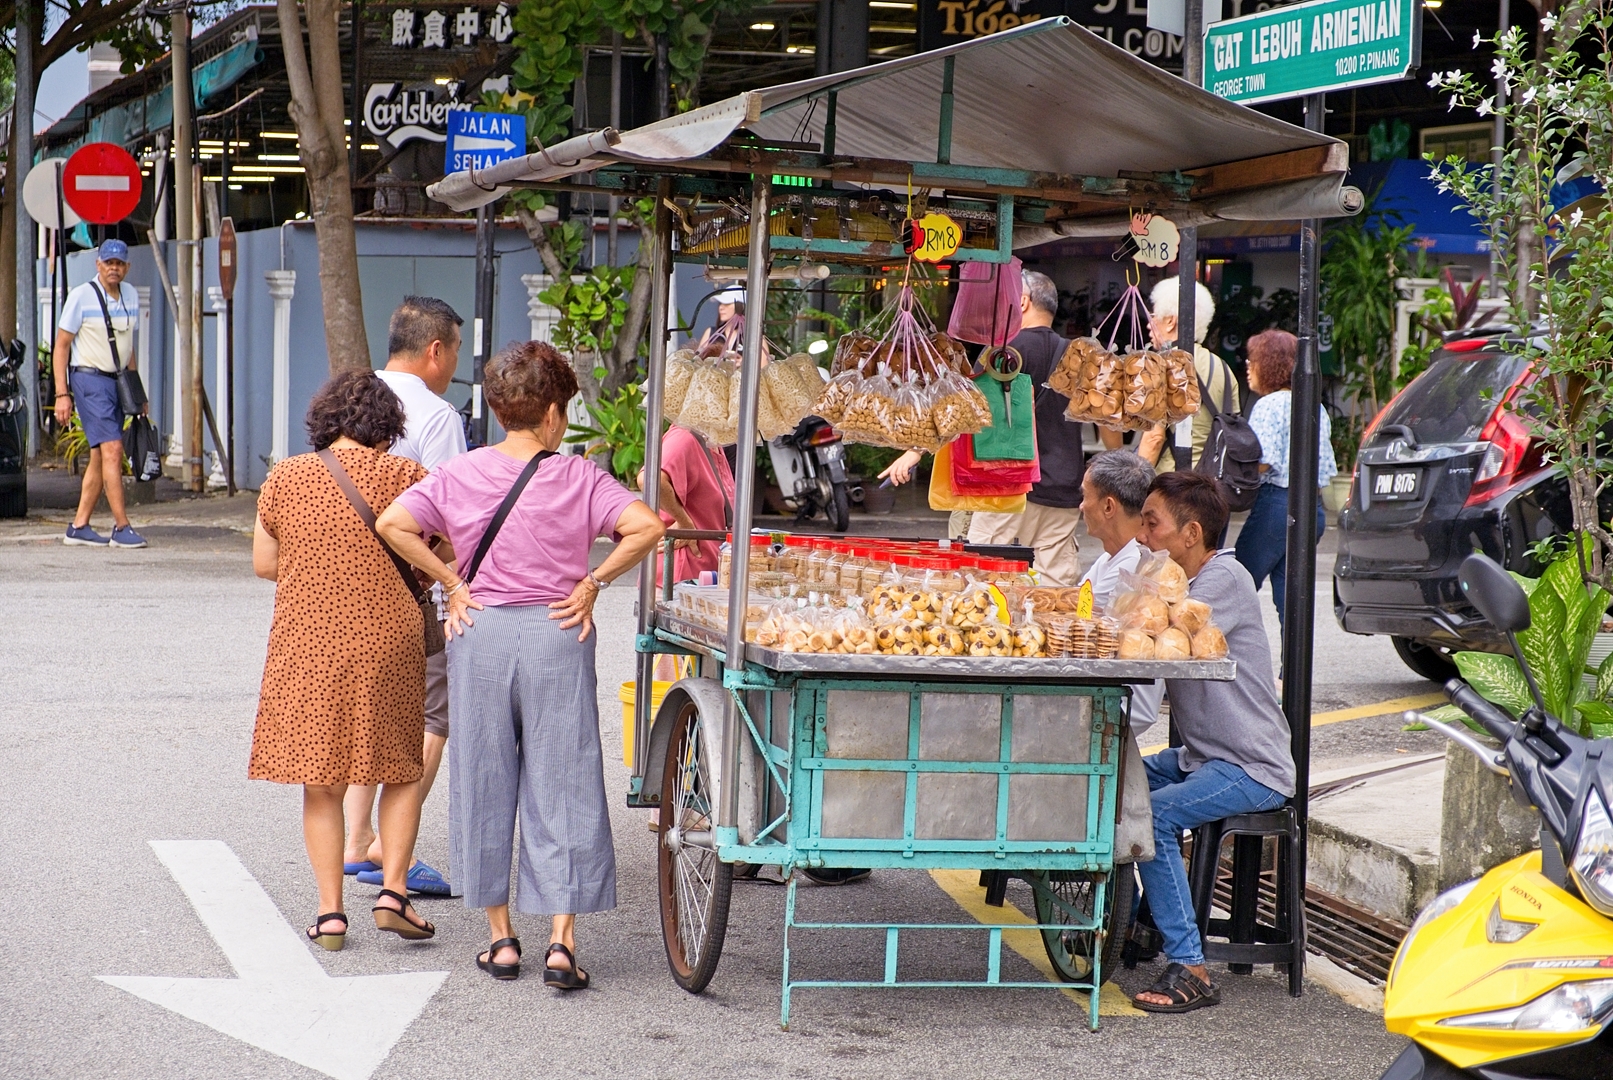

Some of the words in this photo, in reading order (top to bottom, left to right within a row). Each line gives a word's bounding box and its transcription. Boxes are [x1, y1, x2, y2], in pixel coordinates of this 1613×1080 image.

[391, 3, 514, 49] 飲食中心
[1214, 32, 1243, 73] GAT
[1251, 19, 1302, 65] LEBUH
[1310, 1, 1401, 53] ARMENIAN
[1335, 57, 1357, 76] 10200
[1360, 48, 1400, 72] P.PINANG
[1213, 78, 1243, 98] GEORGE
[1245, 73, 1266, 93] TOWN
[460, 116, 511, 135] JALAN
[453, 153, 513, 171] SEHA
[1394, 473, 1416, 493] 8176
[1510, 885, 1543, 911] HONDA
